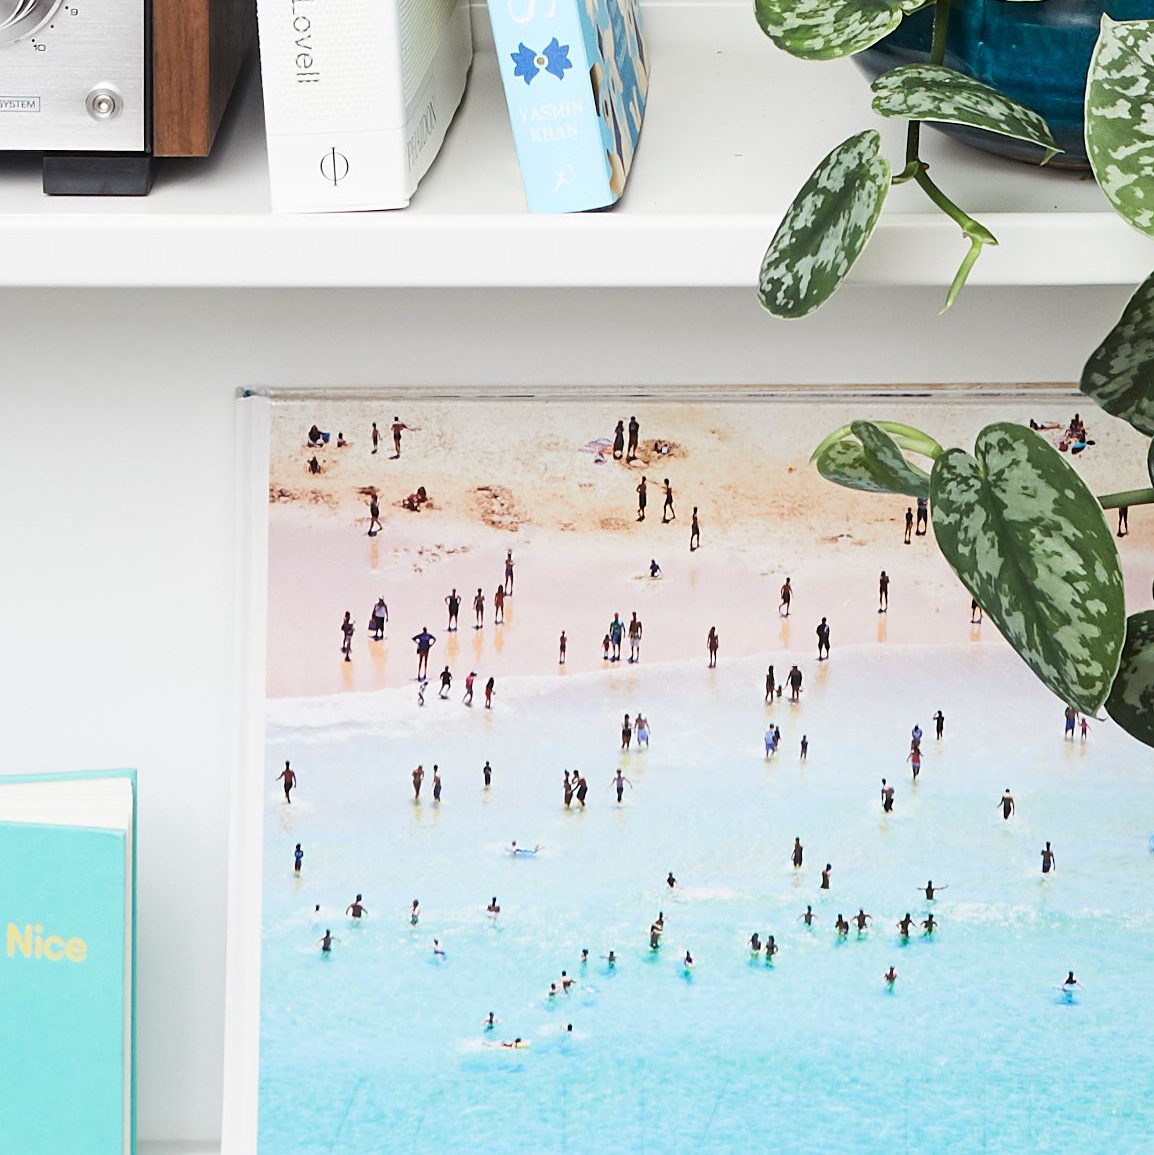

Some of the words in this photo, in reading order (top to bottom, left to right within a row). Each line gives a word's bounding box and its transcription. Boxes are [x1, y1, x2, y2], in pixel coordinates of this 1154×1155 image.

[518, 99, 585, 123] YASMIN
[529, 121, 580, 142] KHAN
[7, 922, 88, 962] Nice
